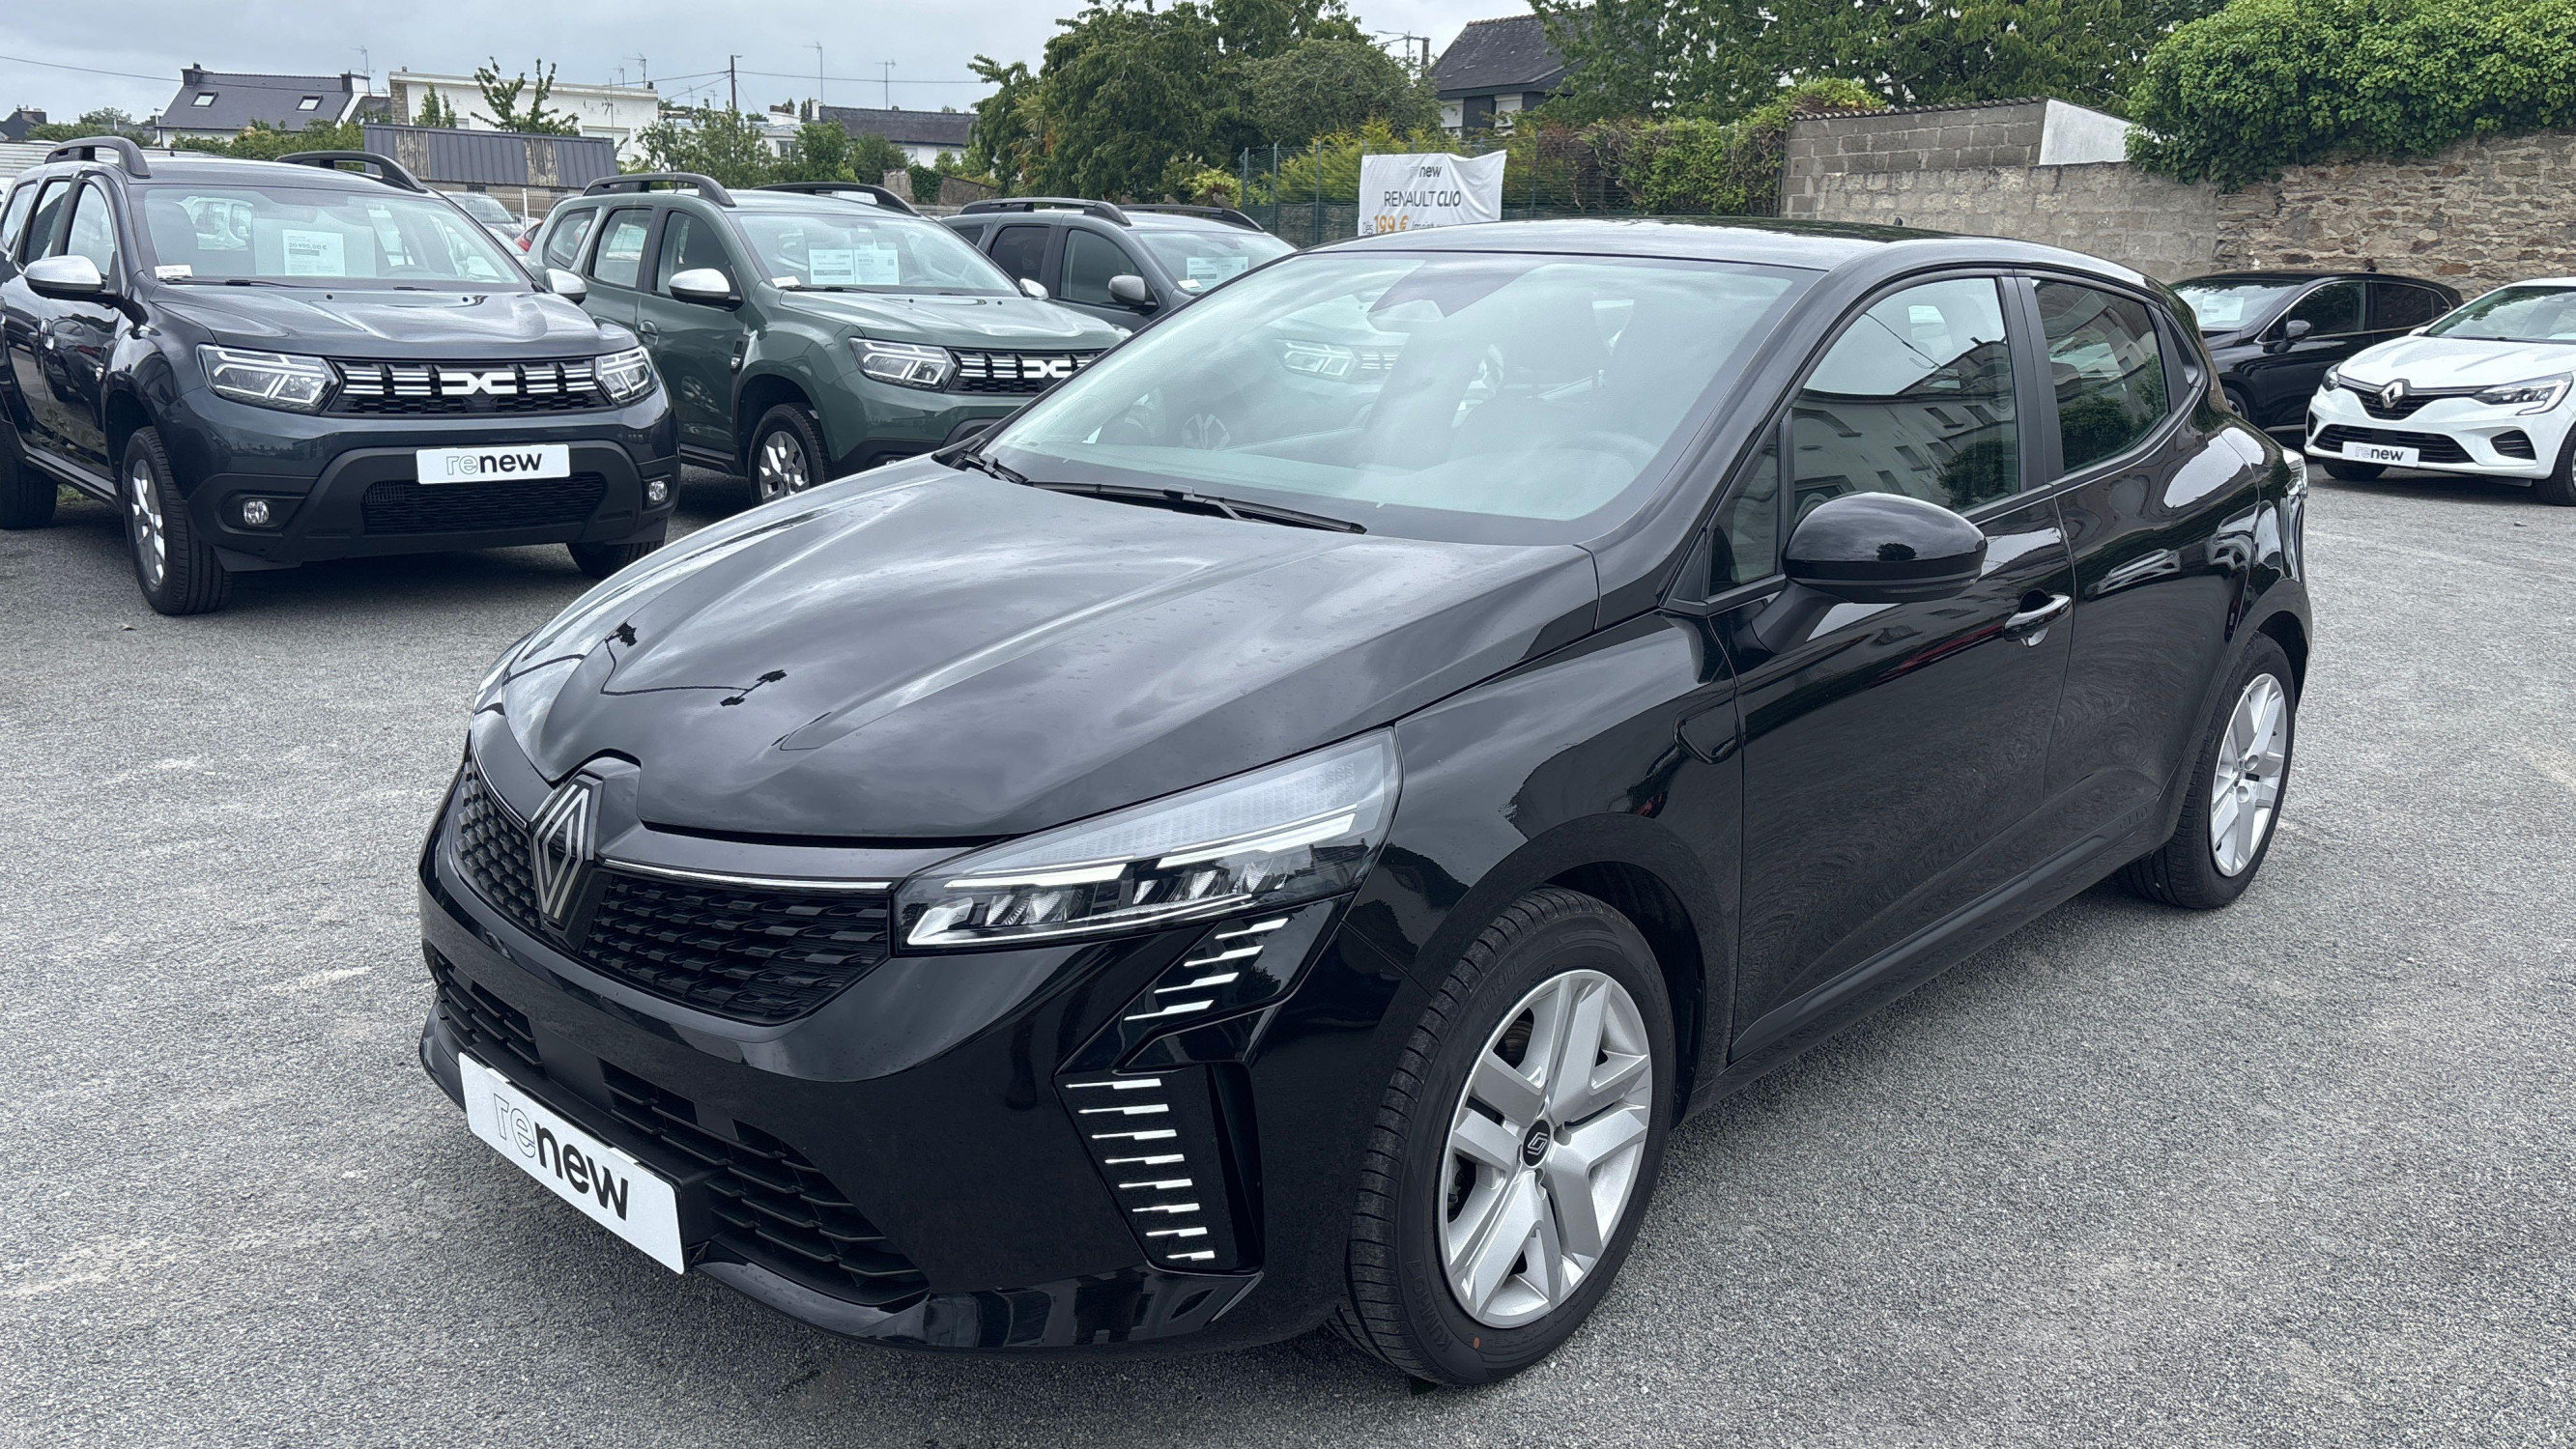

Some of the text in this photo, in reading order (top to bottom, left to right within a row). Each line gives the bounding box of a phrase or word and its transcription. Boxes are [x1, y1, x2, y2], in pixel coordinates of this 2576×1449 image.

[1384, 190, 1462, 207] RENAULT CLIO
[1374, 214, 1395, 233] 199
[1399, 214, 1409, 232] €
[2355, 446, 2405, 461] renew
[445, 453, 543, 475] renew
[493, 1093, 629, 1221] renew
